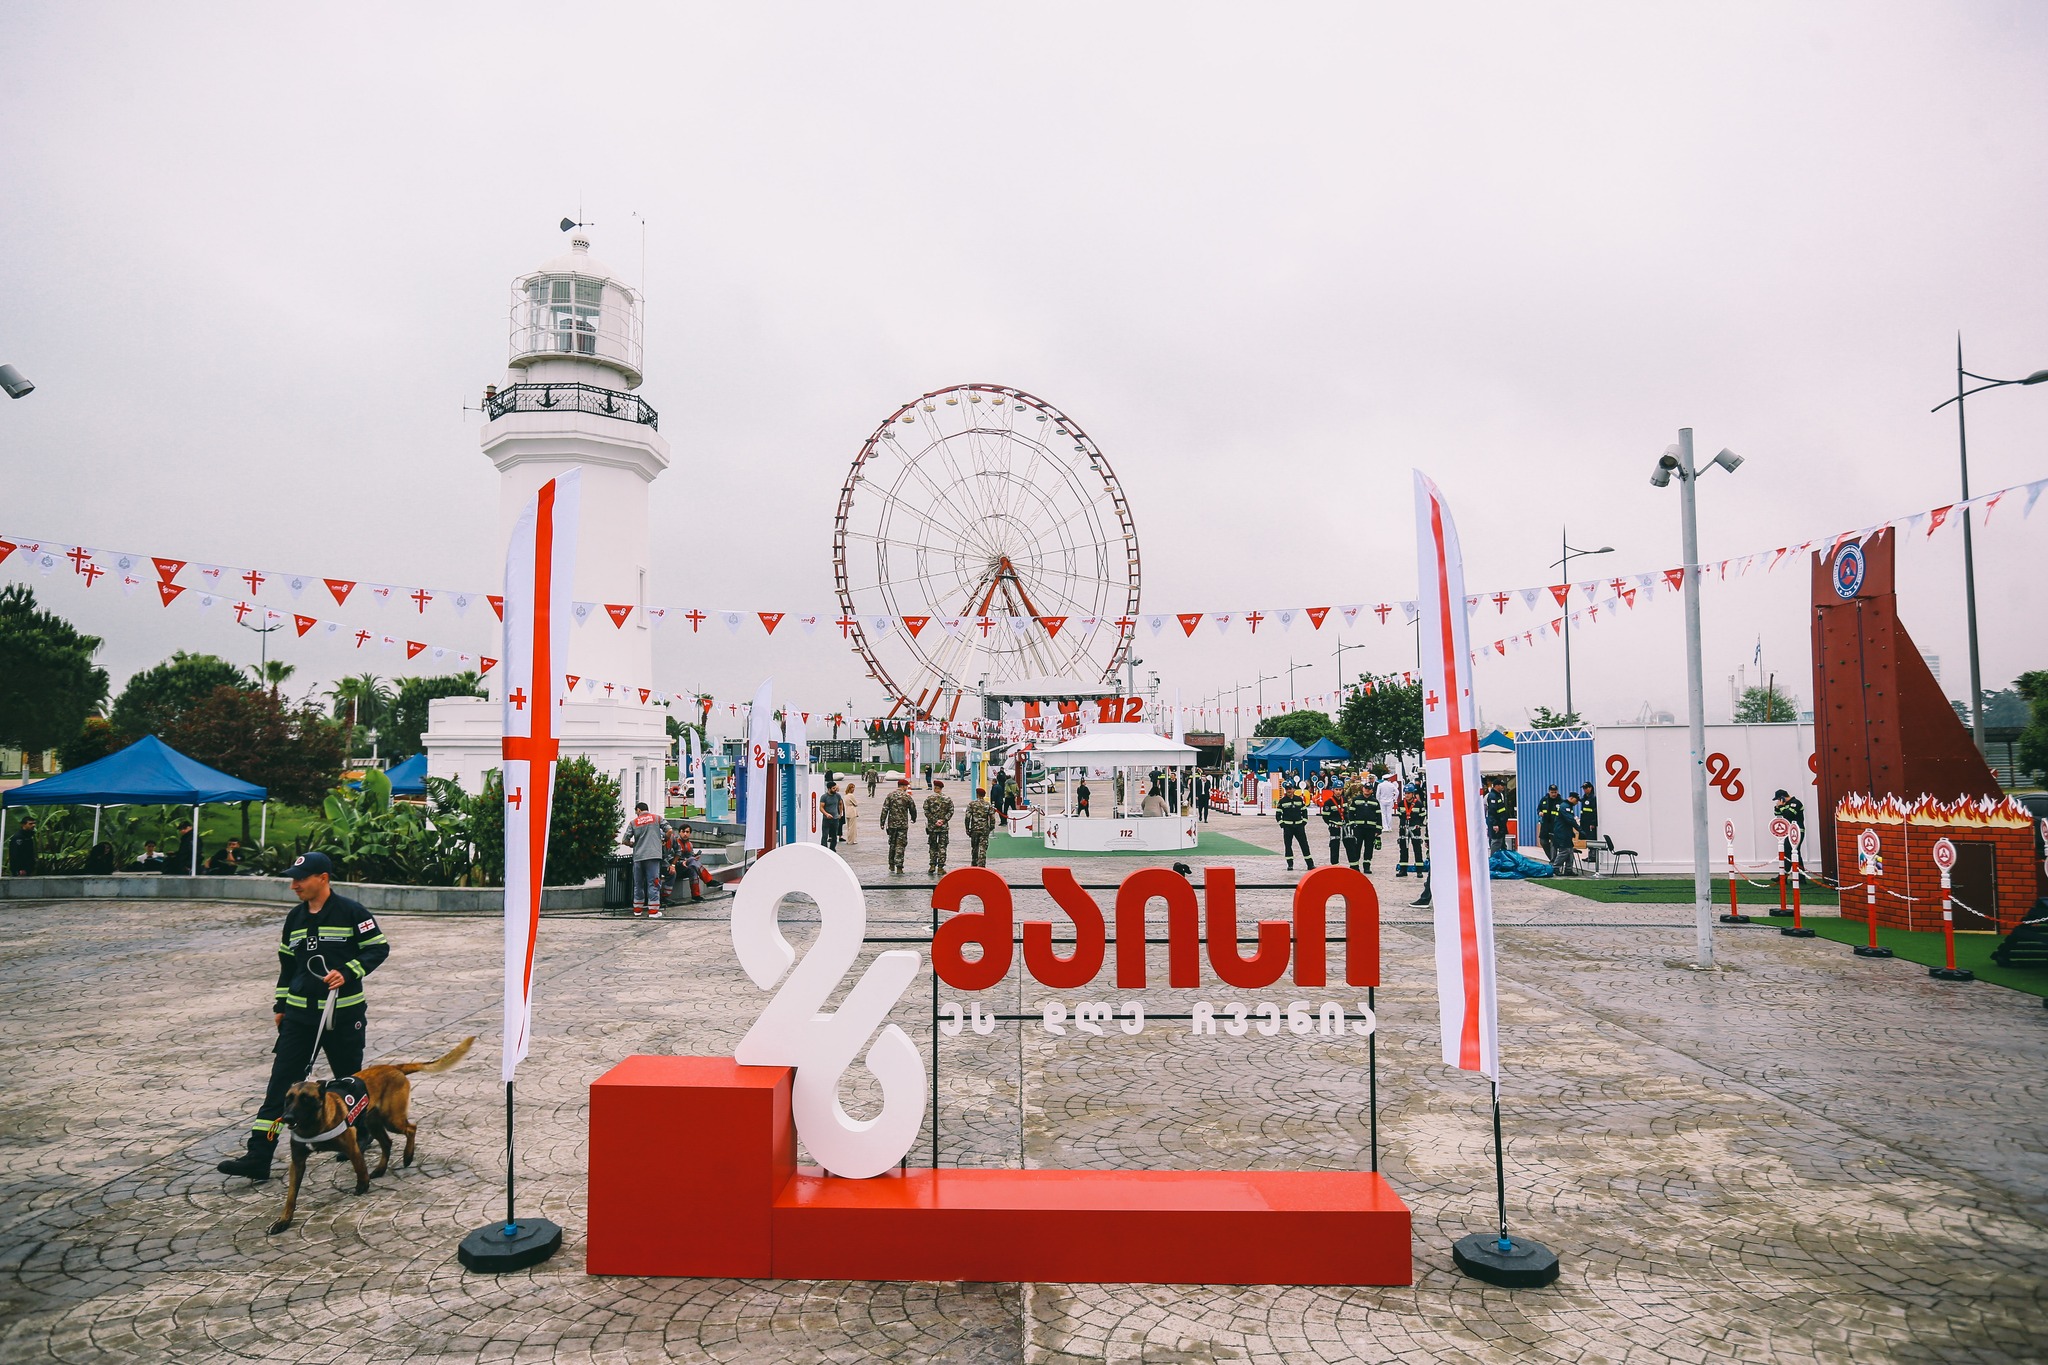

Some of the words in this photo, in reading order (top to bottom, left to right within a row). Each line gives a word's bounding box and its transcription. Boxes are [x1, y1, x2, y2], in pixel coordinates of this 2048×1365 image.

[1096, 697, 1143, 723] 112
[1605, 754, 1643, 803] 26
[1706, 752, 1745, 802] 26
[1120, 829, 1133, 837] 112
[931, 865, 1380, 991] მაისი
[730, 842, 928, 1180] 26
[939, 1001, 995, 1037] ეს
[1043, 1001, 1144, 1036] დღე
[1192, 1000, 1376, 1036] ჩვენია
